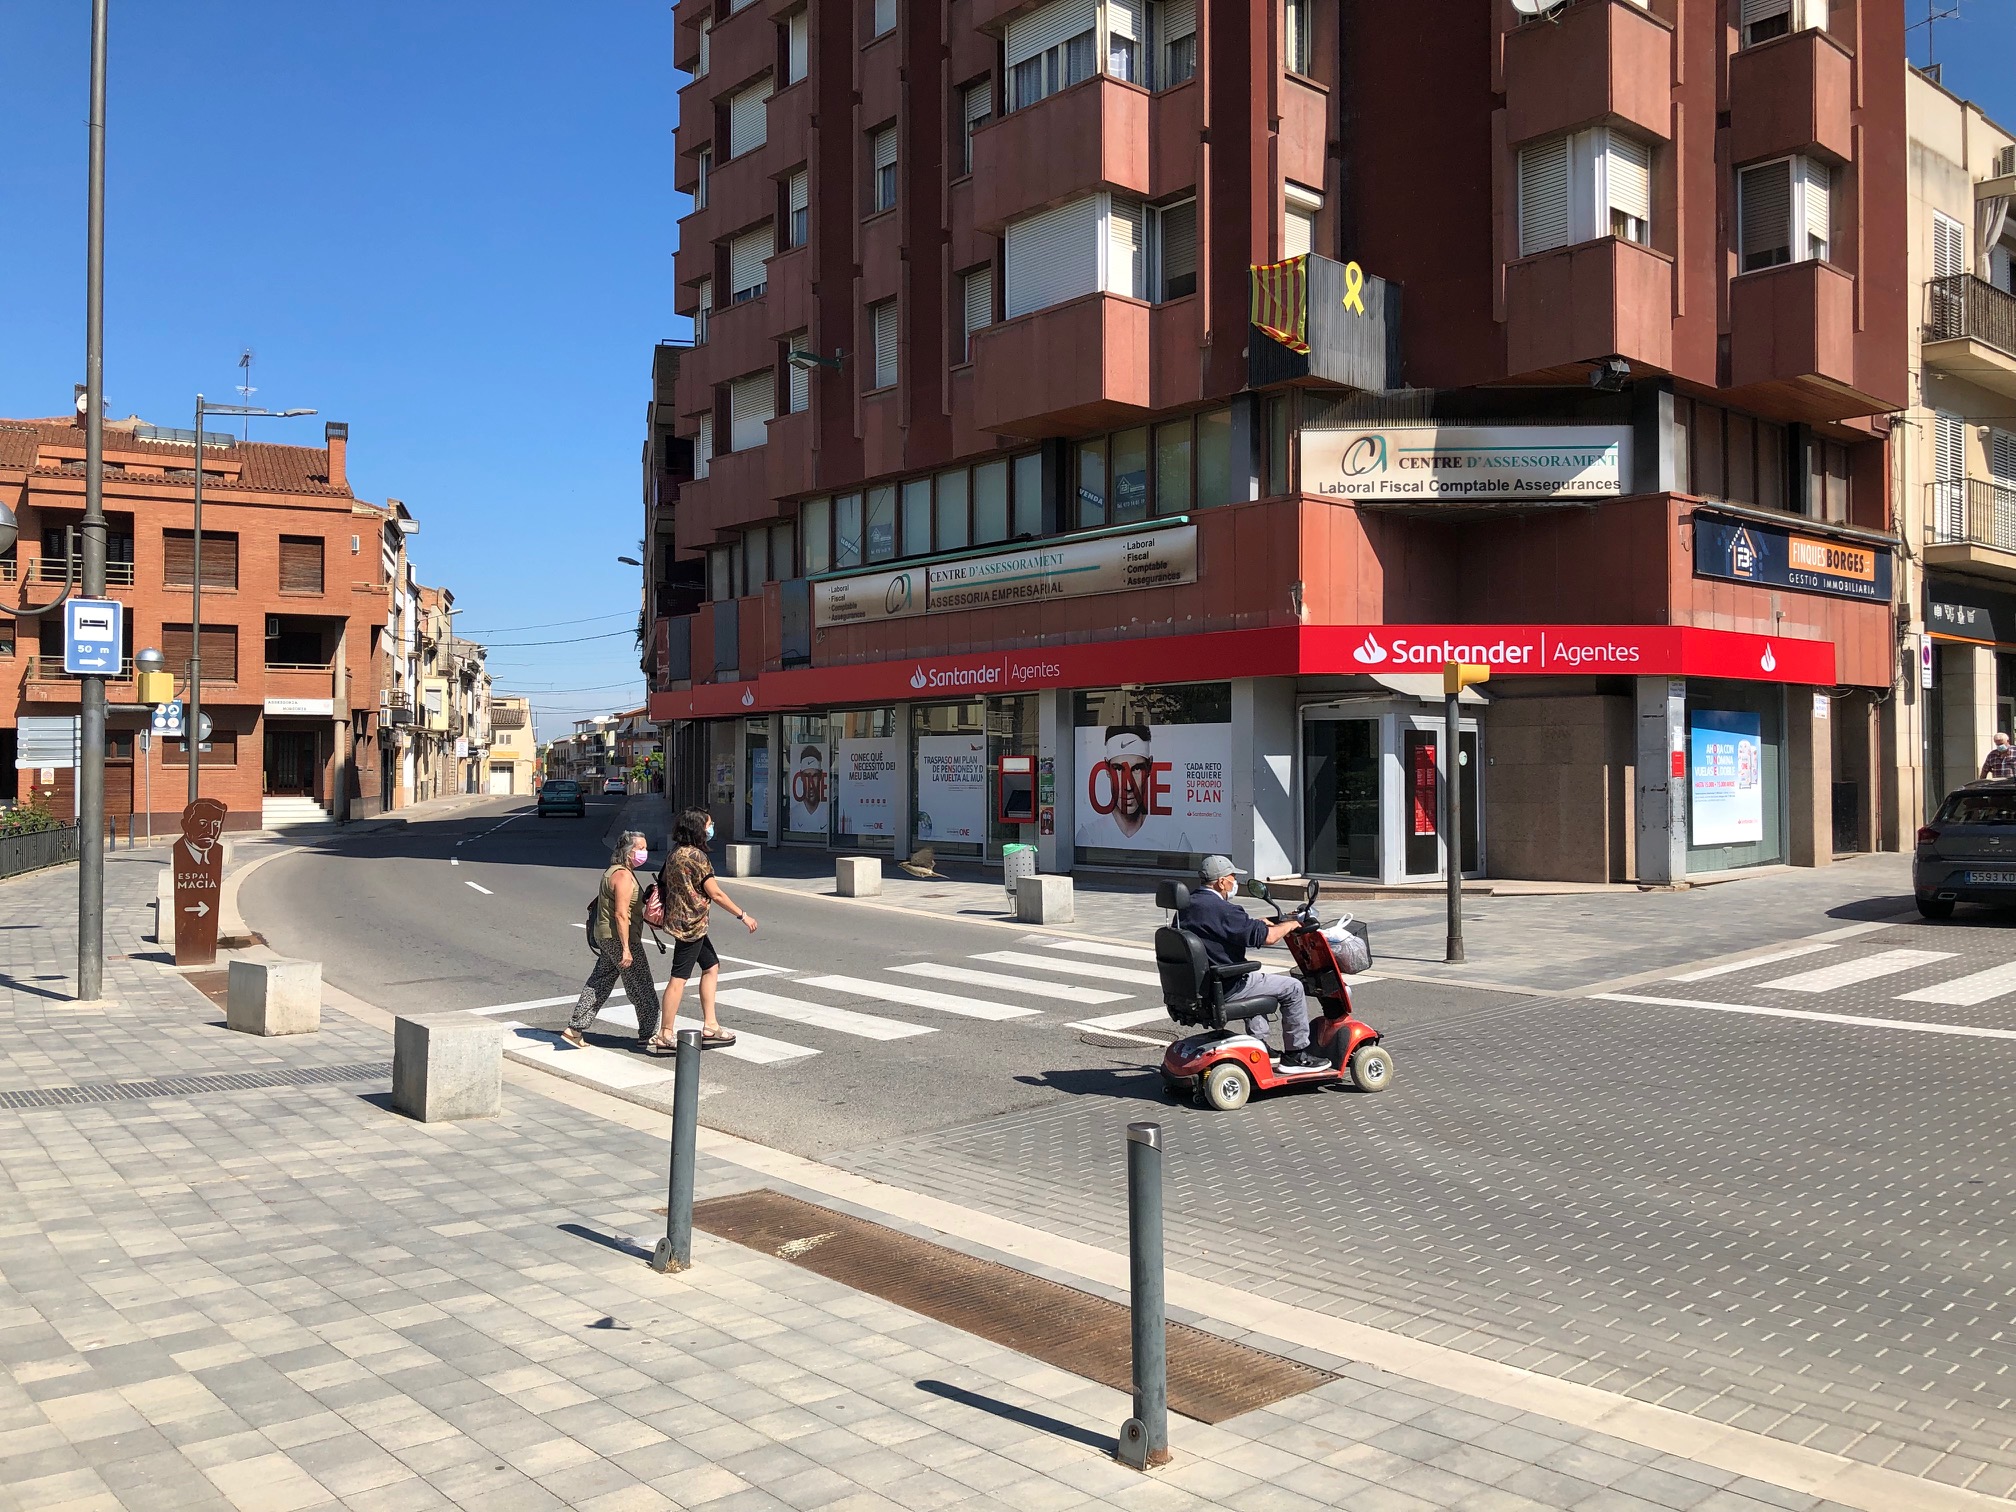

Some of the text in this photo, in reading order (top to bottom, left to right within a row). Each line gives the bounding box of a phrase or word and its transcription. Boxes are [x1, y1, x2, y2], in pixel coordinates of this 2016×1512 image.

[1399, 454, 1618, 470] CENTRE D'ASSESSORAMENT
[1319, 478, 1622, 495] Laboral Fiscal Comptable Assegurances
[1080, 488, 1103, 505] VENDA
[1127, 538, 1155, 550] Laboral
[1127, 551, 1149, 562] Fiscal
[1792, 542, 1826, 568] FINQUES
[1826, 548, 1864, 574] BORGES
[930, 553, 1064, 583] CENTRE D'ASSESSORAMENT
[1127, 560, 1168, 574] Comptable
[1127, 571, 1180, 586] Assegurances
[1788, 572, 1818, 587] GESTIÓ
[831, 584, 850, 594] Laboral
[930, 582, 1064, 608] ASSESSORIA EMPRESARIAL
[831, 594, 846, 602] Fiscal
[831, 603, 858, 612] Comptable
[831, 612, 866, 622] Assegurances
[78, 644, 92, 654] 50
[1392, 640, 1640, 666] Santander Agentes
[928, 662, 1060, 687] Santander Agentes
[850, 752, 870, 762] CONEC
[924, 756, 952, 764] TRASPASO
[954, 756, 961, 764] MI
[854, 762, 885, 771] NECESSITO
[933, 765, 940, 773] DE
[941, 765, 974, 773] PENSIONES
[849, 771, 879, 780] MEU BANC
[792, 771, 827, 802] ONE
[1088, 760, 1172, 816] ONE
[1972, 873, 1998, 881] 5593
